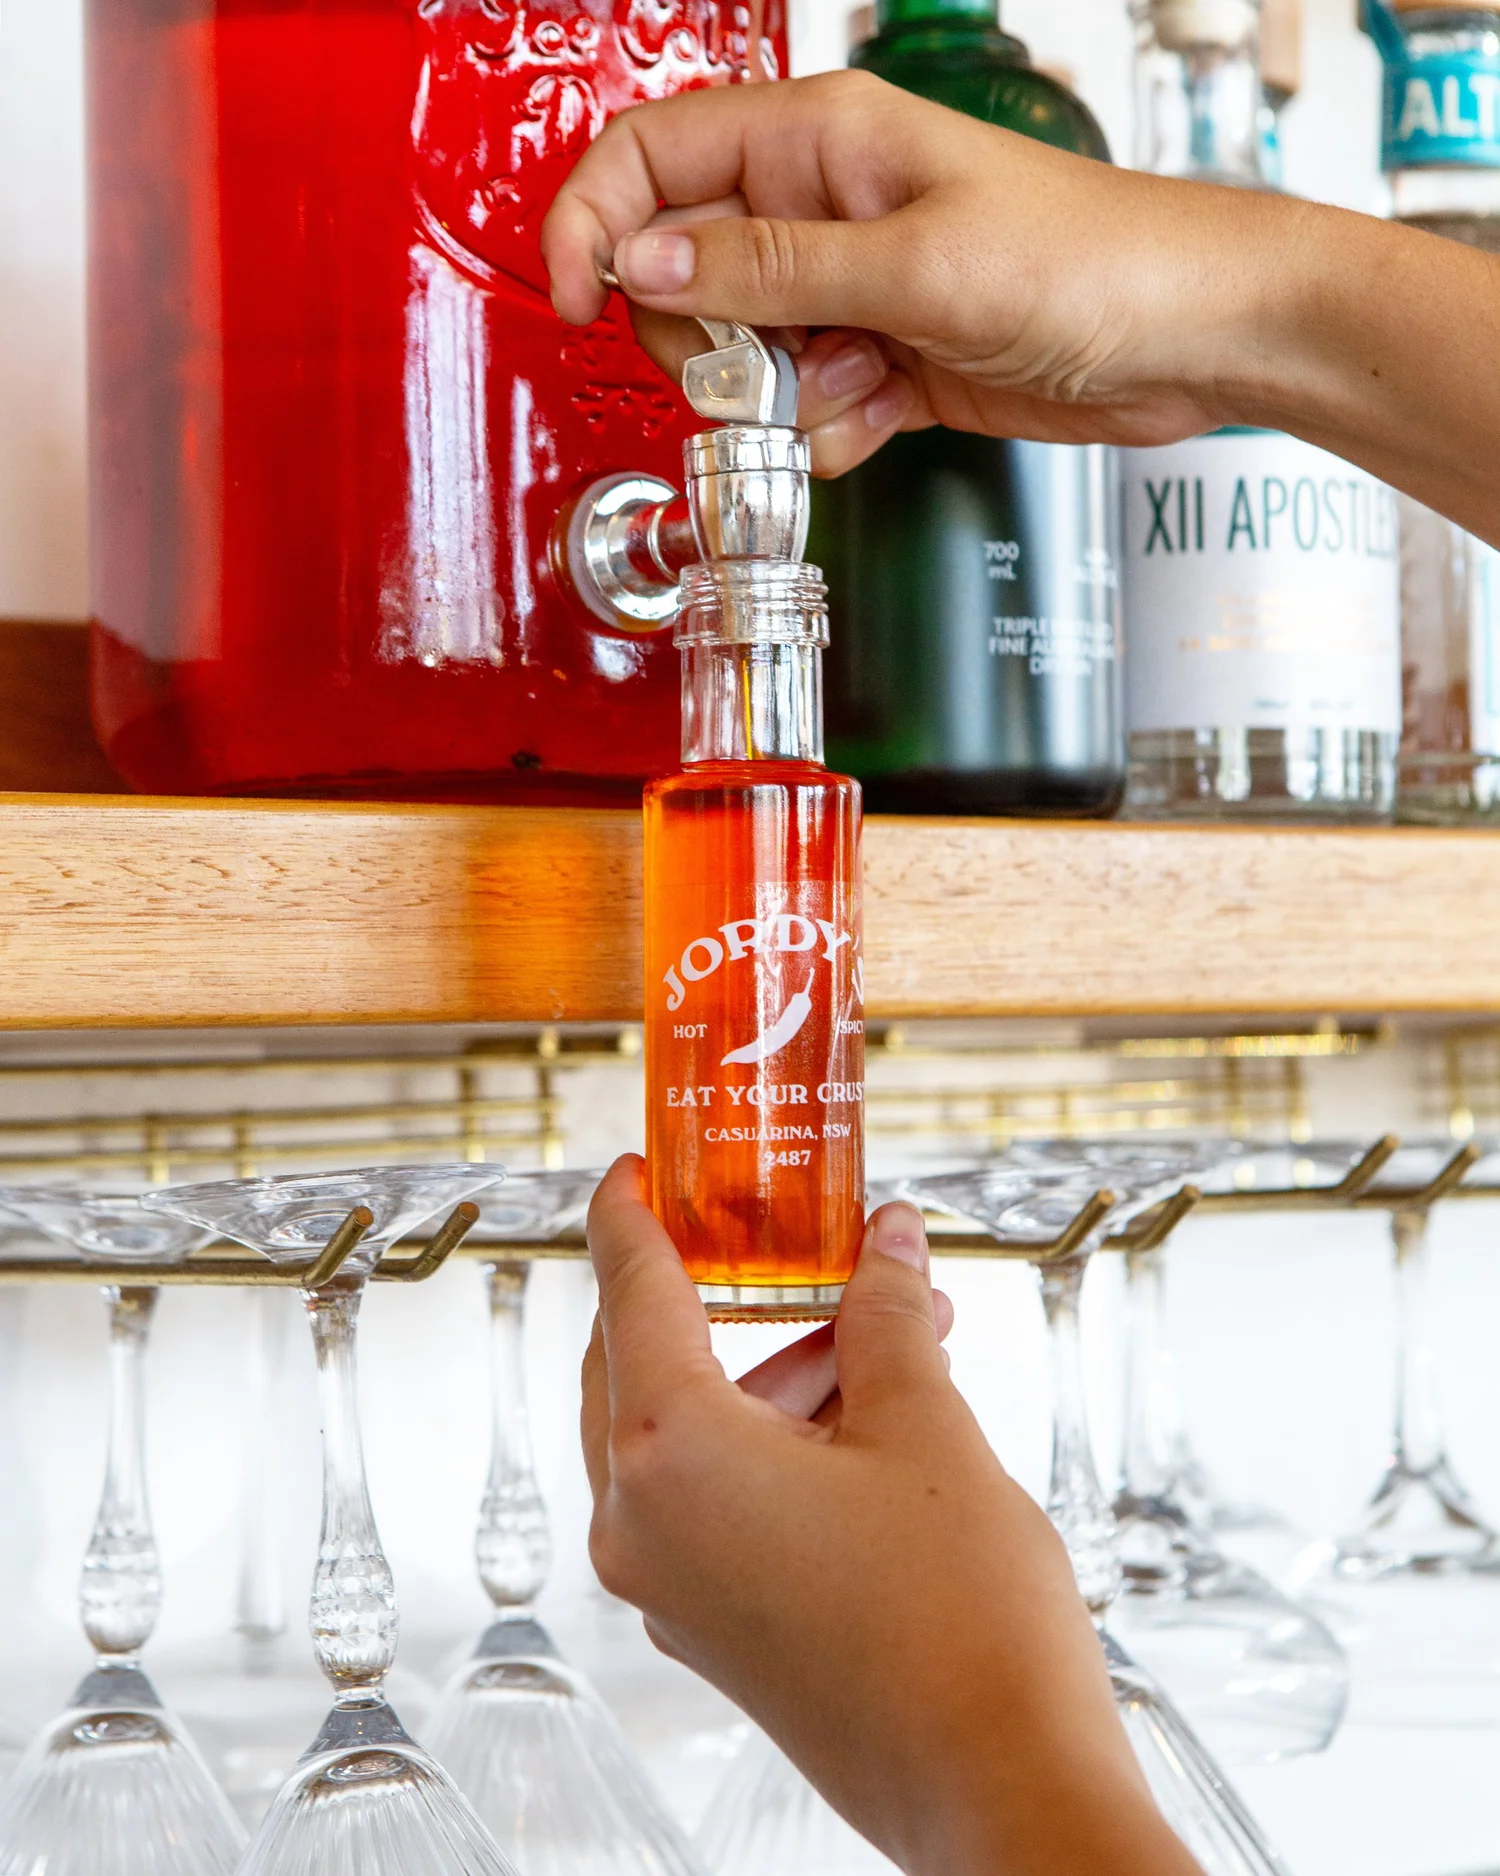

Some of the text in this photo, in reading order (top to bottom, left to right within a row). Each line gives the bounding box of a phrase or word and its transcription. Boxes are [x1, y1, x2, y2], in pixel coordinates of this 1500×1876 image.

[1143, 476, 1205, 556] XII
[983, 540, 1020, 562] 700
[673, 1023, 708, 1039] HOT
[666, 1085, 716, 1108] EAT
[725, 1084, 810, 1106] YOUR
[704, 1121, 852, 1142] CASUARINA, NSW
[763, 1149, 811, 1167] 2487
